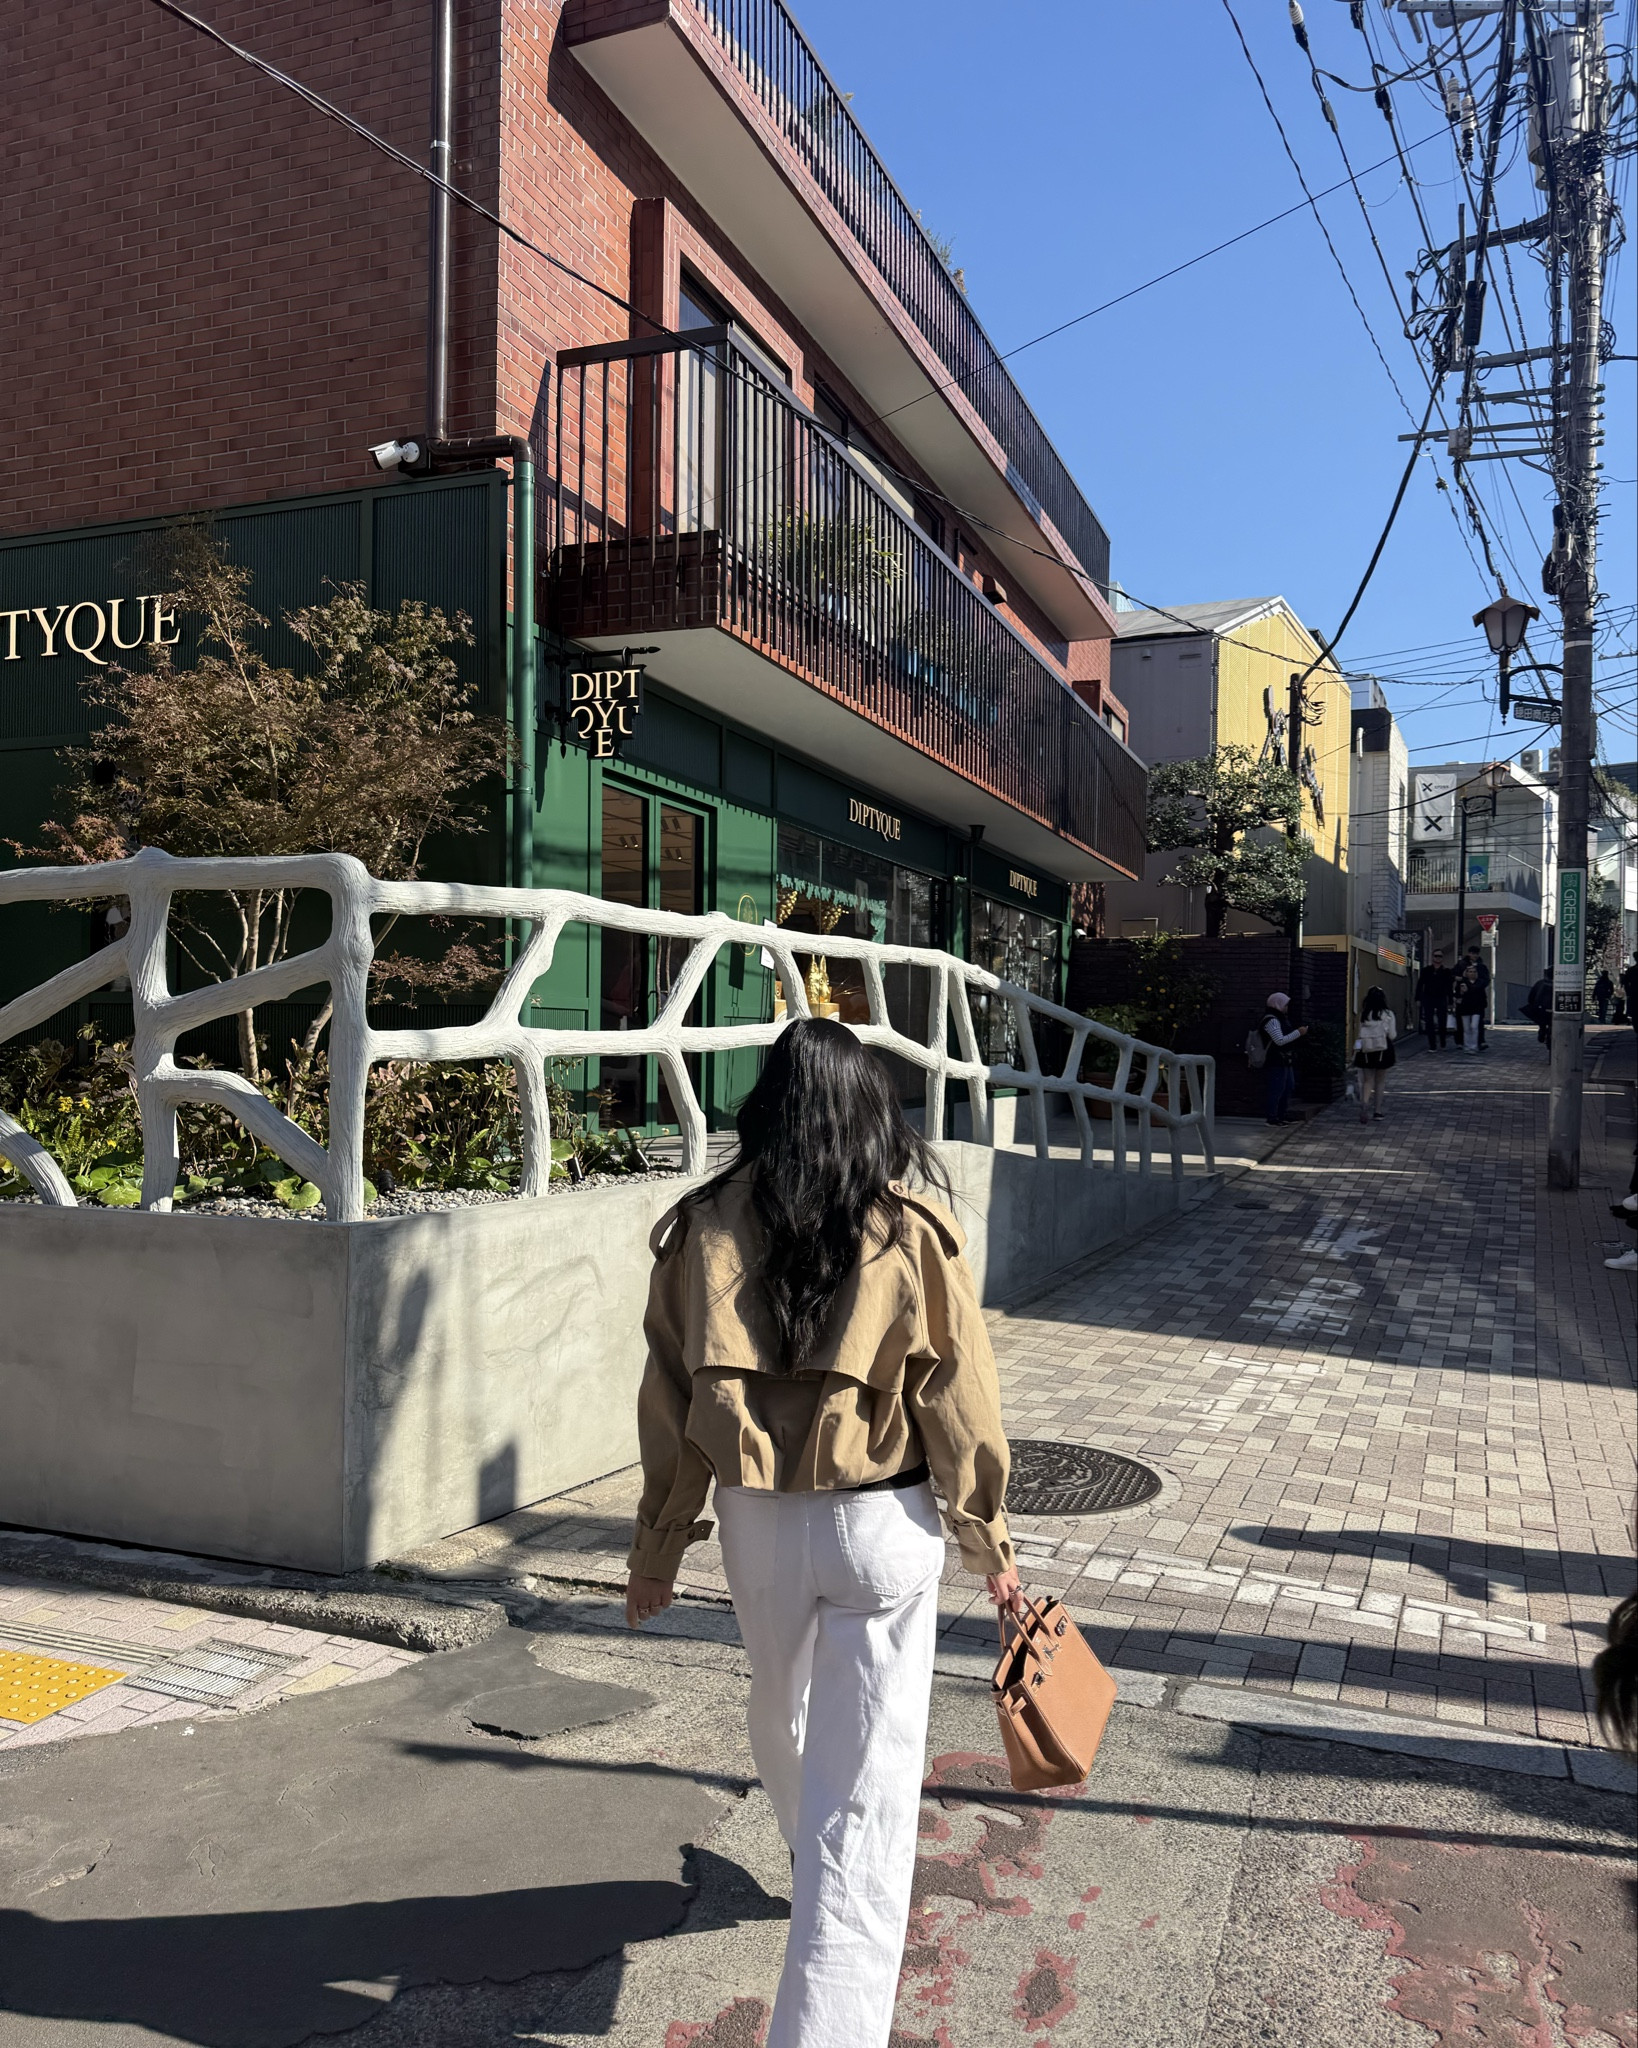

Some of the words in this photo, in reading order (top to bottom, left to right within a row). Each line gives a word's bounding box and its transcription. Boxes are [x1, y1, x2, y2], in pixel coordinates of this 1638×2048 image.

[0, 595, 180, 665] TYQUE
[571, 669, 640, 700] DIPT
[594, 728, 615, 757] E
[849, 798, 900, 841] DIPTYQUE
[1009, 870, 1038, 898] DIPTYQUE
[1563, 888, 1577, 929] GREEN
[1562, 931, 1576, 962] SEED
